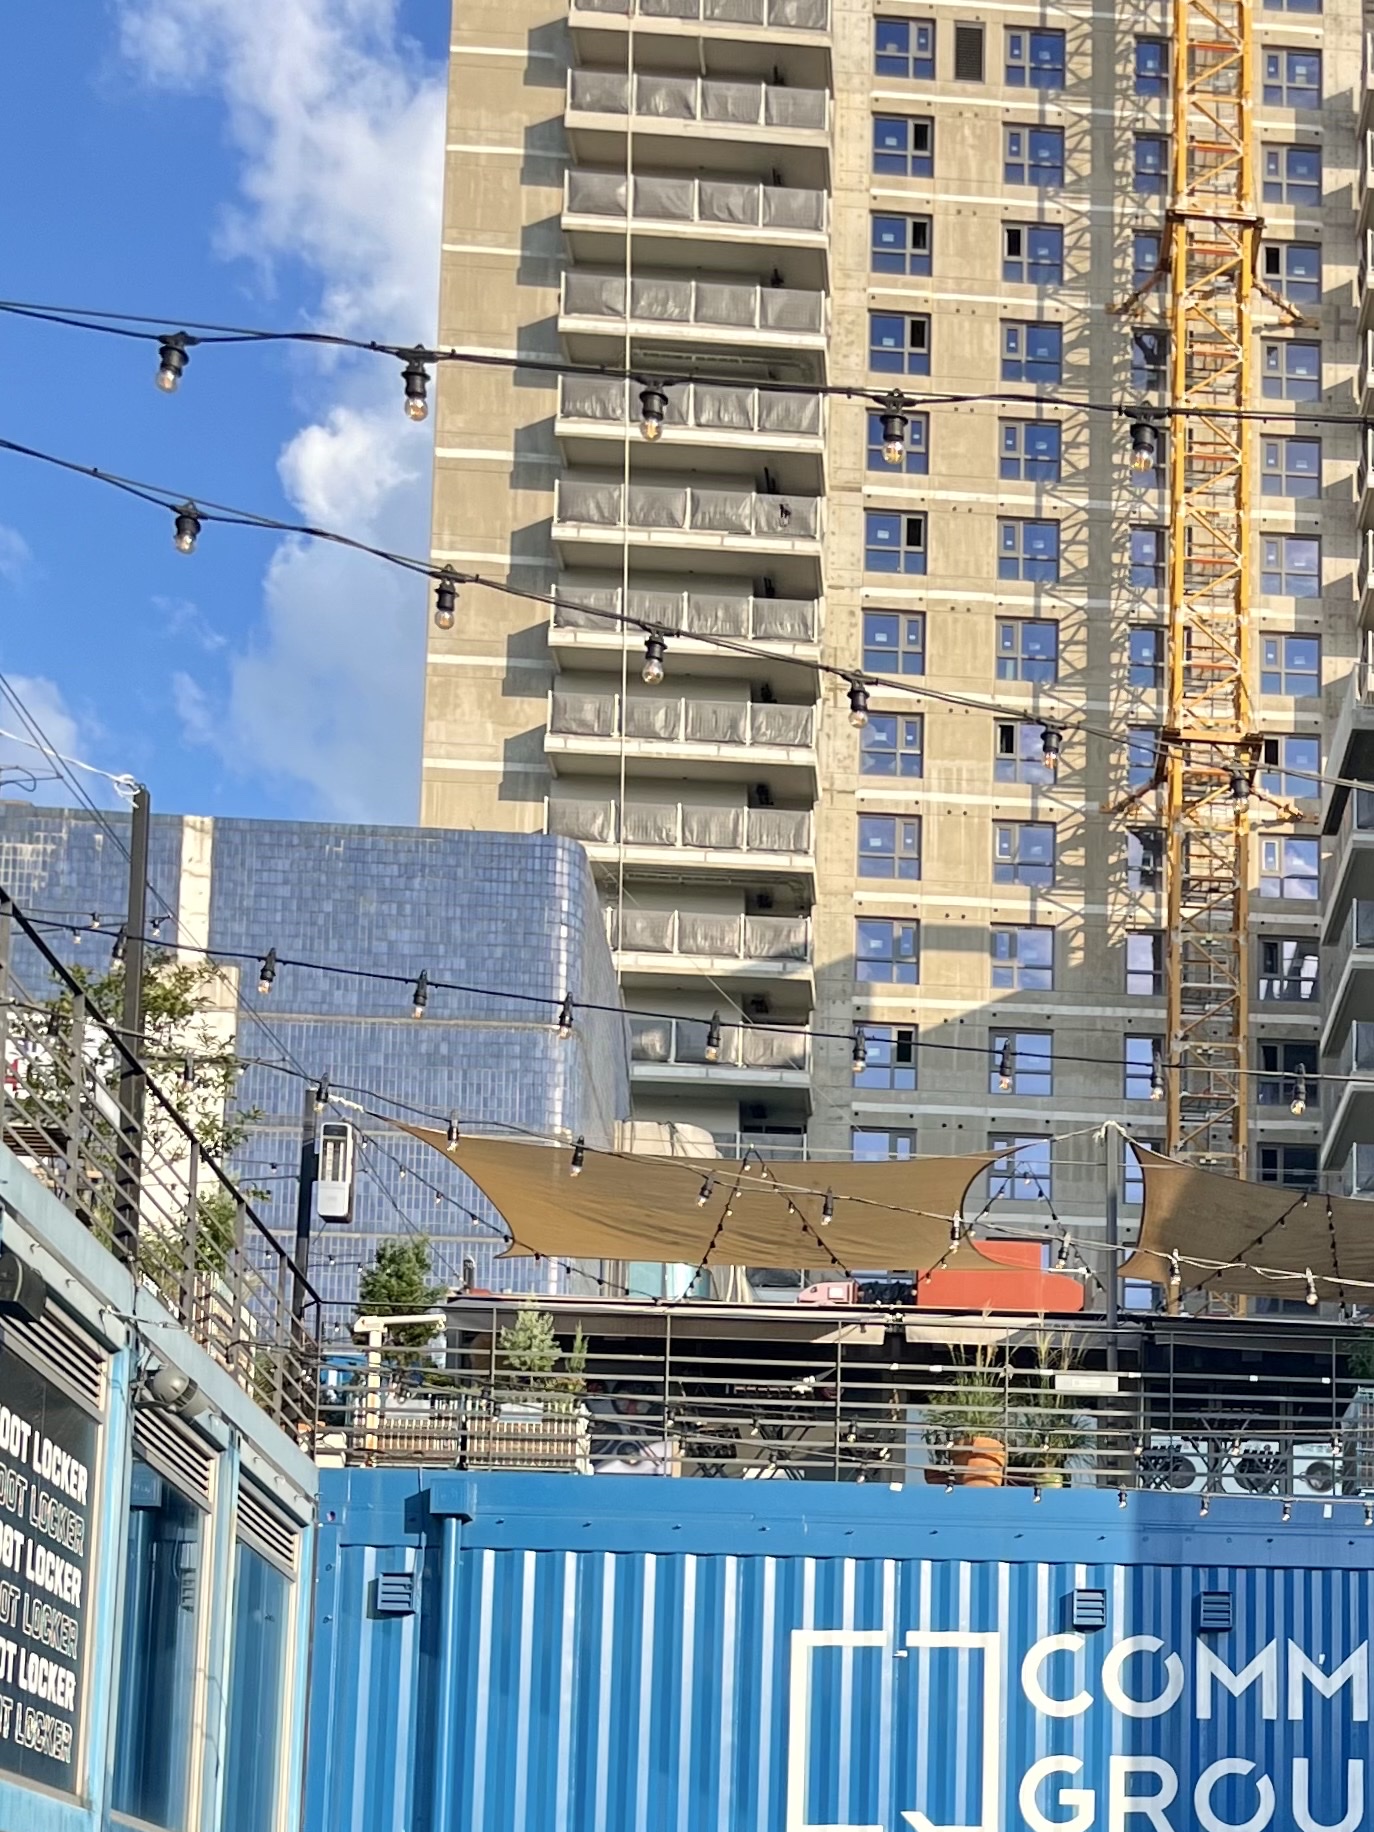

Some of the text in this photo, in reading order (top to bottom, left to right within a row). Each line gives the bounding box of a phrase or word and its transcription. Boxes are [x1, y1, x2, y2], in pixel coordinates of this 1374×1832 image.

[0, 1403, 88, 1506] OOT LOCKER
[29, 1484, 85, 1557] LOCKER
[0, 1519, 82, 1608] OT LOCKER
[22, 1592, 79, 1660] LOCKER
[18, 1647, 77, 1712] LOCKER
[0, 1694, 73, 1764] T LOCKER
